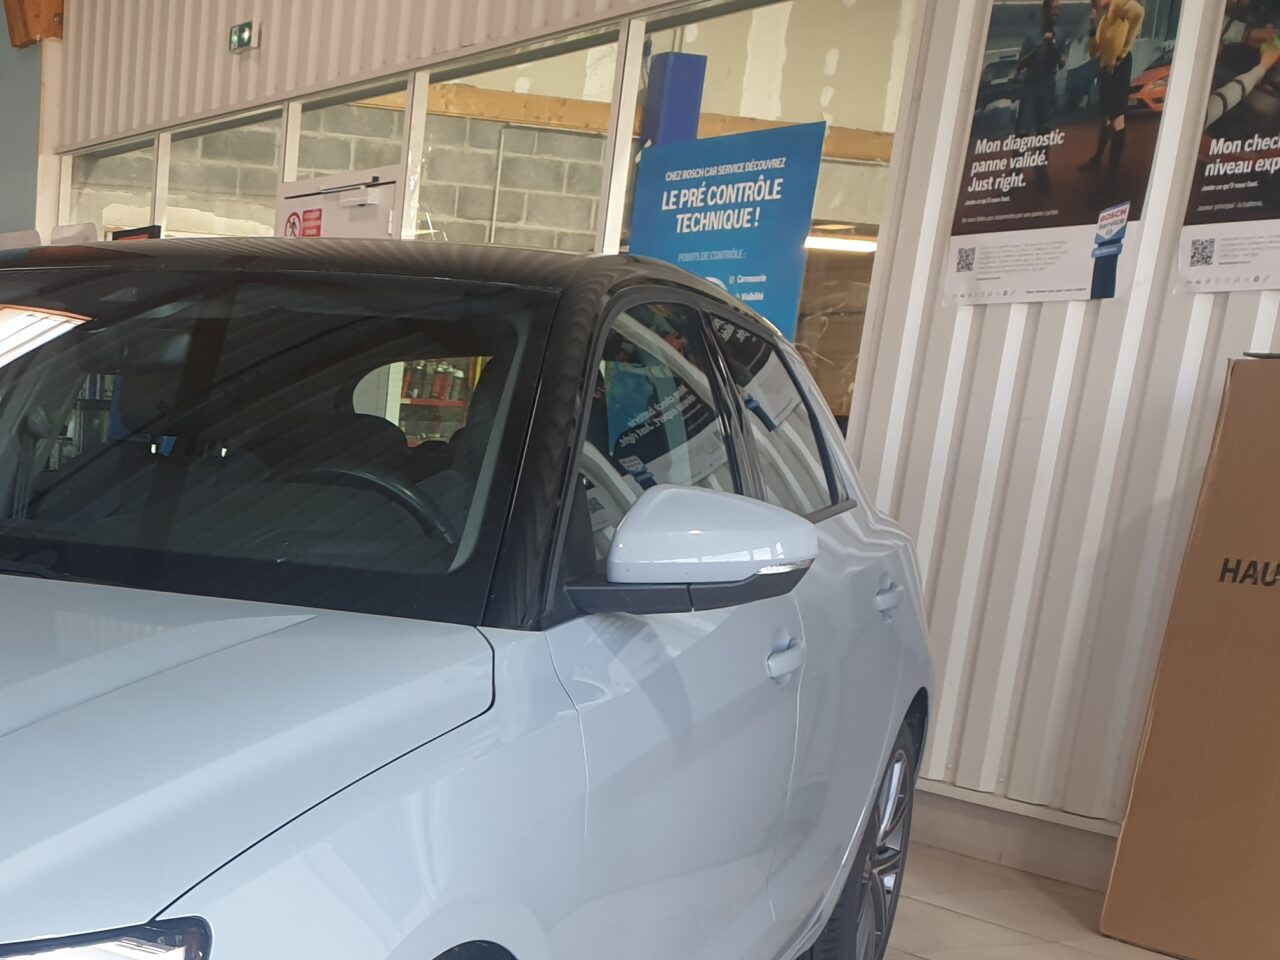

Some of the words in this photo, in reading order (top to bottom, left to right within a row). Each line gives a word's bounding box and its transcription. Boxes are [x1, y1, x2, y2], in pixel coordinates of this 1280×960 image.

[975, 138, 1001, 154] Mon
[1003, 129, 1065, 153] diagnostic
[1209, 138, 1242, 156] Mon
[665, 169, 682, 181] CHEZ
[682, 167, 704, 180] BOSCH
[704, 165, 718, 177] CAR
[718, 162, 745, 175] SERVICE
[745, 157, 786, 173] DÉCOUVREZ
[970, 158, 1007, 177] panne
[1009, 149, 1048, 169] validé.
[1204, 158, 1253, 177] niveau
[1255, 157, 1280, 175] exp
[661, 190, 679, 210] LE
[679, 181, 706, 208] PRÉ
[707, 174, 784, 206] CONTRÔLE
[967, 176, 994, 192] Just
[994, 172, 1026, 192] right.
[676, 207, 753, 233] TECHNIQUE
[754, 206, 760, 227] !
[700, 250, 709, 261] DE
[710, 247, 743, 260] CONTRÔLE
